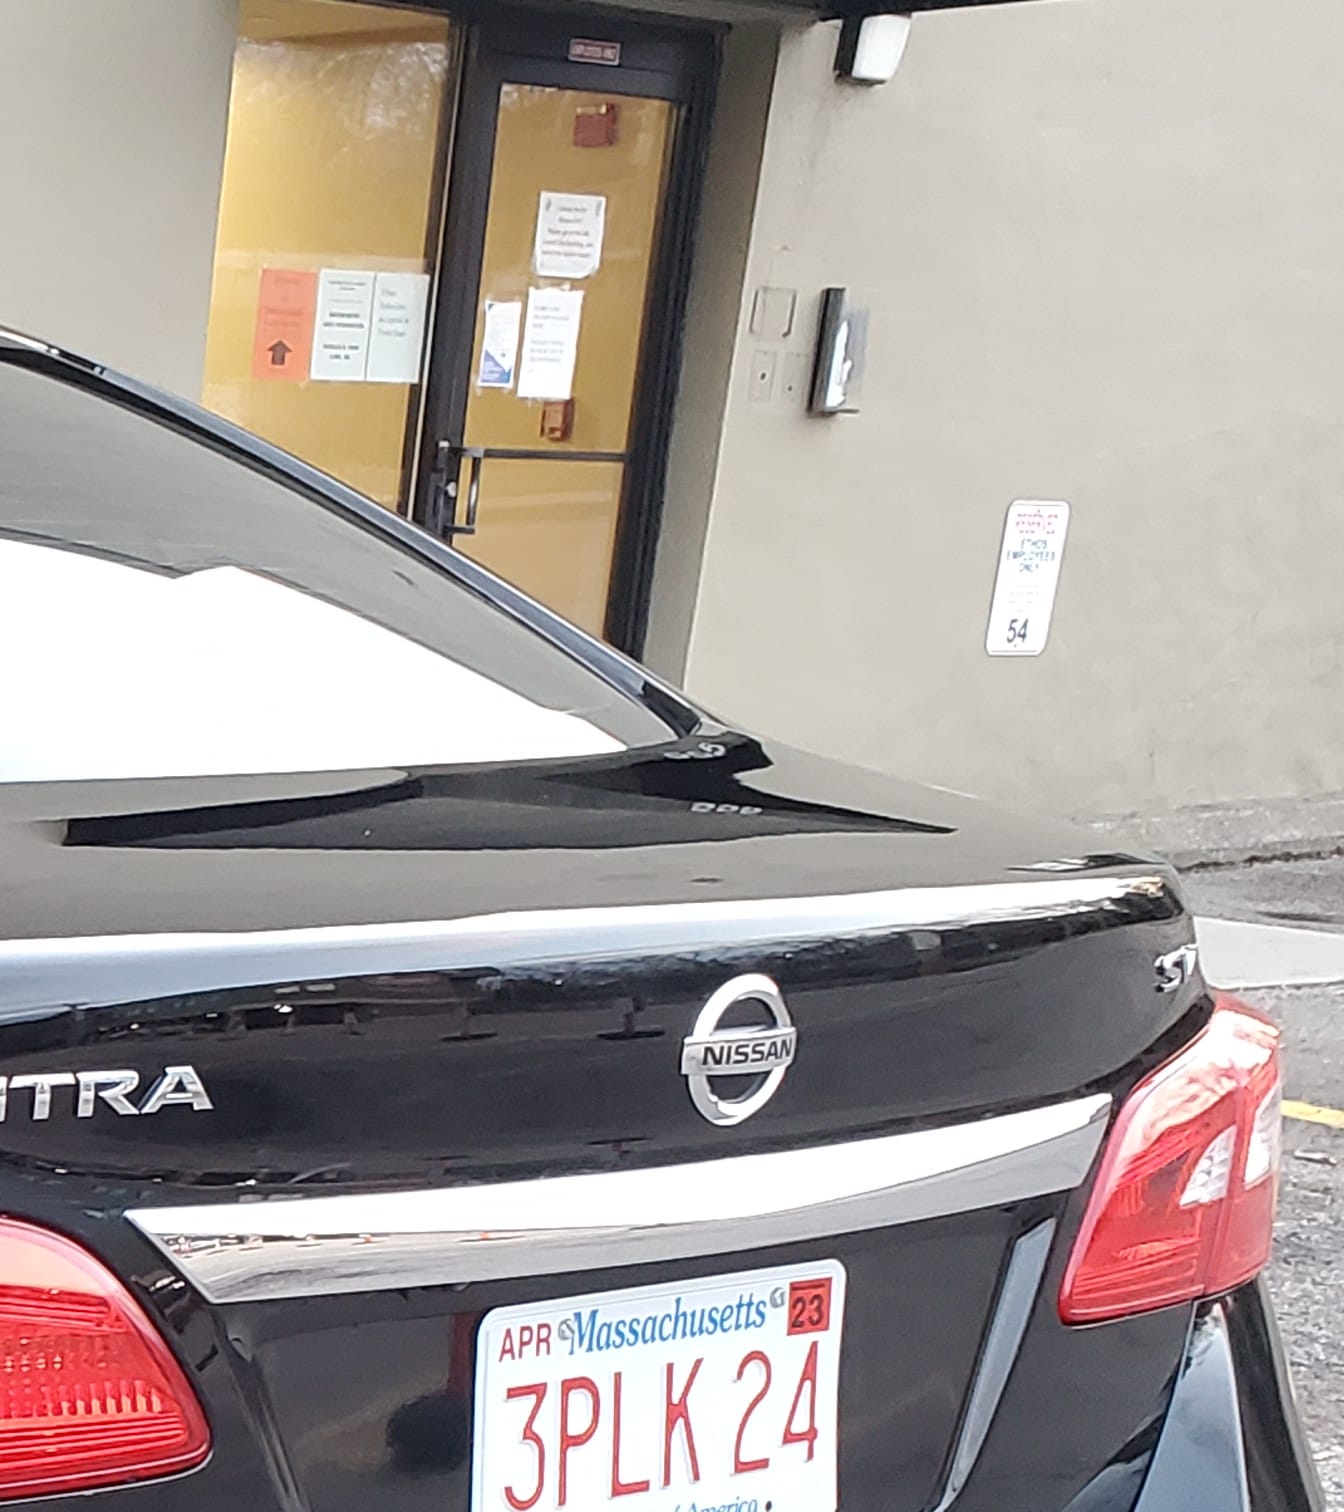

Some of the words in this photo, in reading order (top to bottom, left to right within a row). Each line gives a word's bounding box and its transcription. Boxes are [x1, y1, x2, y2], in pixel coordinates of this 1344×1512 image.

[1006, 618, 1029, 644] 54
[701, 1037, 793, 1067] NISSAN
[498, 1322, 552, 1363] APR
[568, 1293, 767, 1356] Massachusetts
[791, 1293, 825, 1329] 23
[503, 1357, 705, 1512] 3PLK
[732, 1340, 819, 1474] 24
